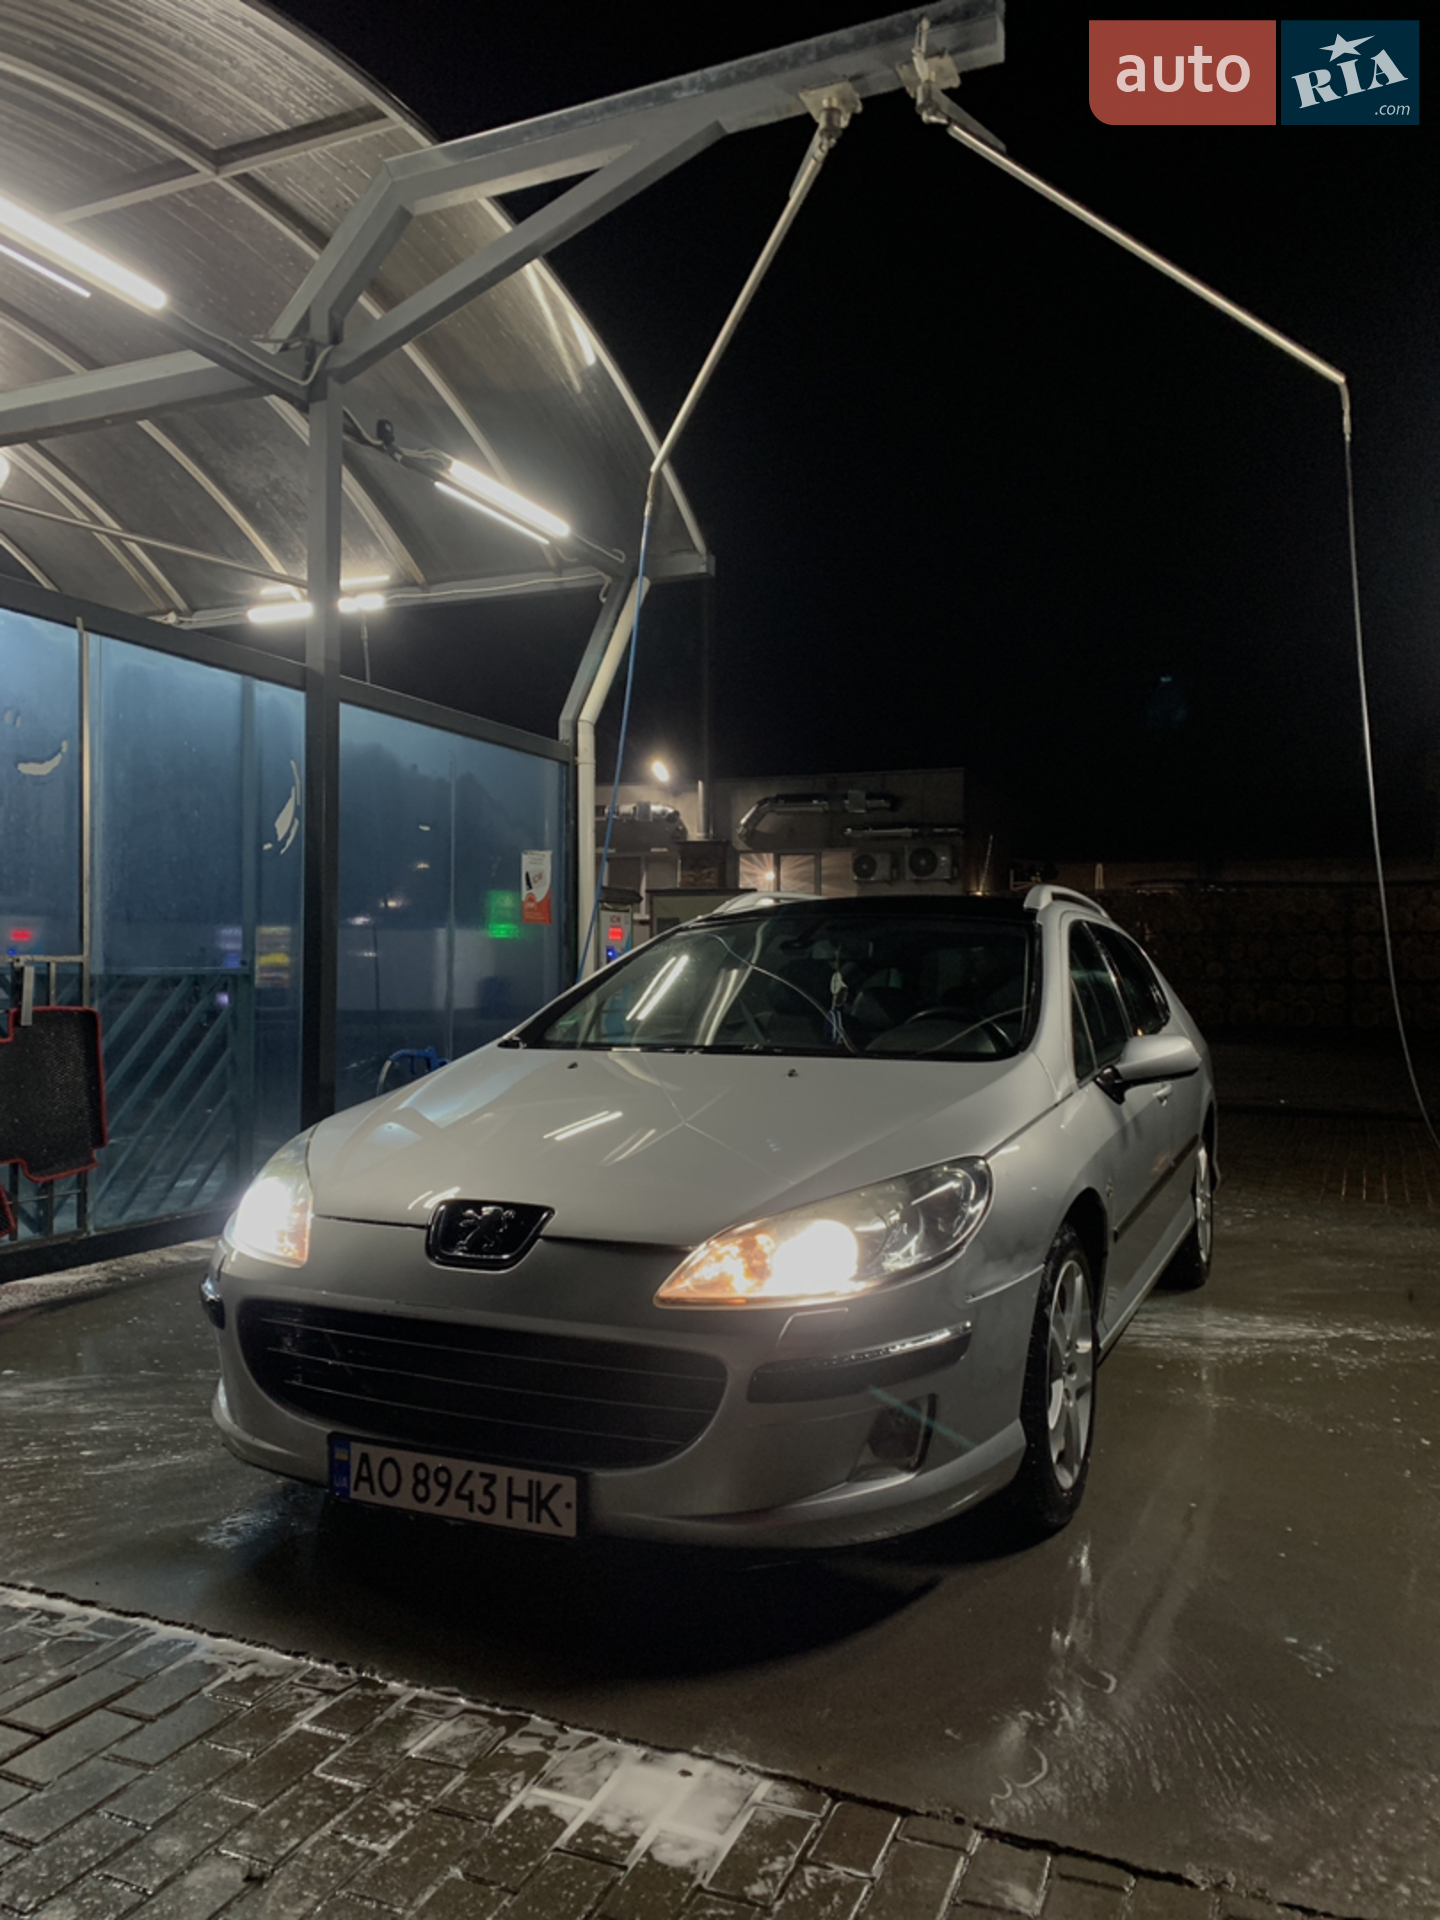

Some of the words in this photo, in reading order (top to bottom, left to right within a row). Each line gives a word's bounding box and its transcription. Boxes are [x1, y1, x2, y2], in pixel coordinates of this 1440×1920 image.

[334, 1474, 349, 1488] UA
[353, 1452, 402, 1498] AO
[412, 1462, 498, 1515] 8943
[506, 1476, 563, 1528] HK
